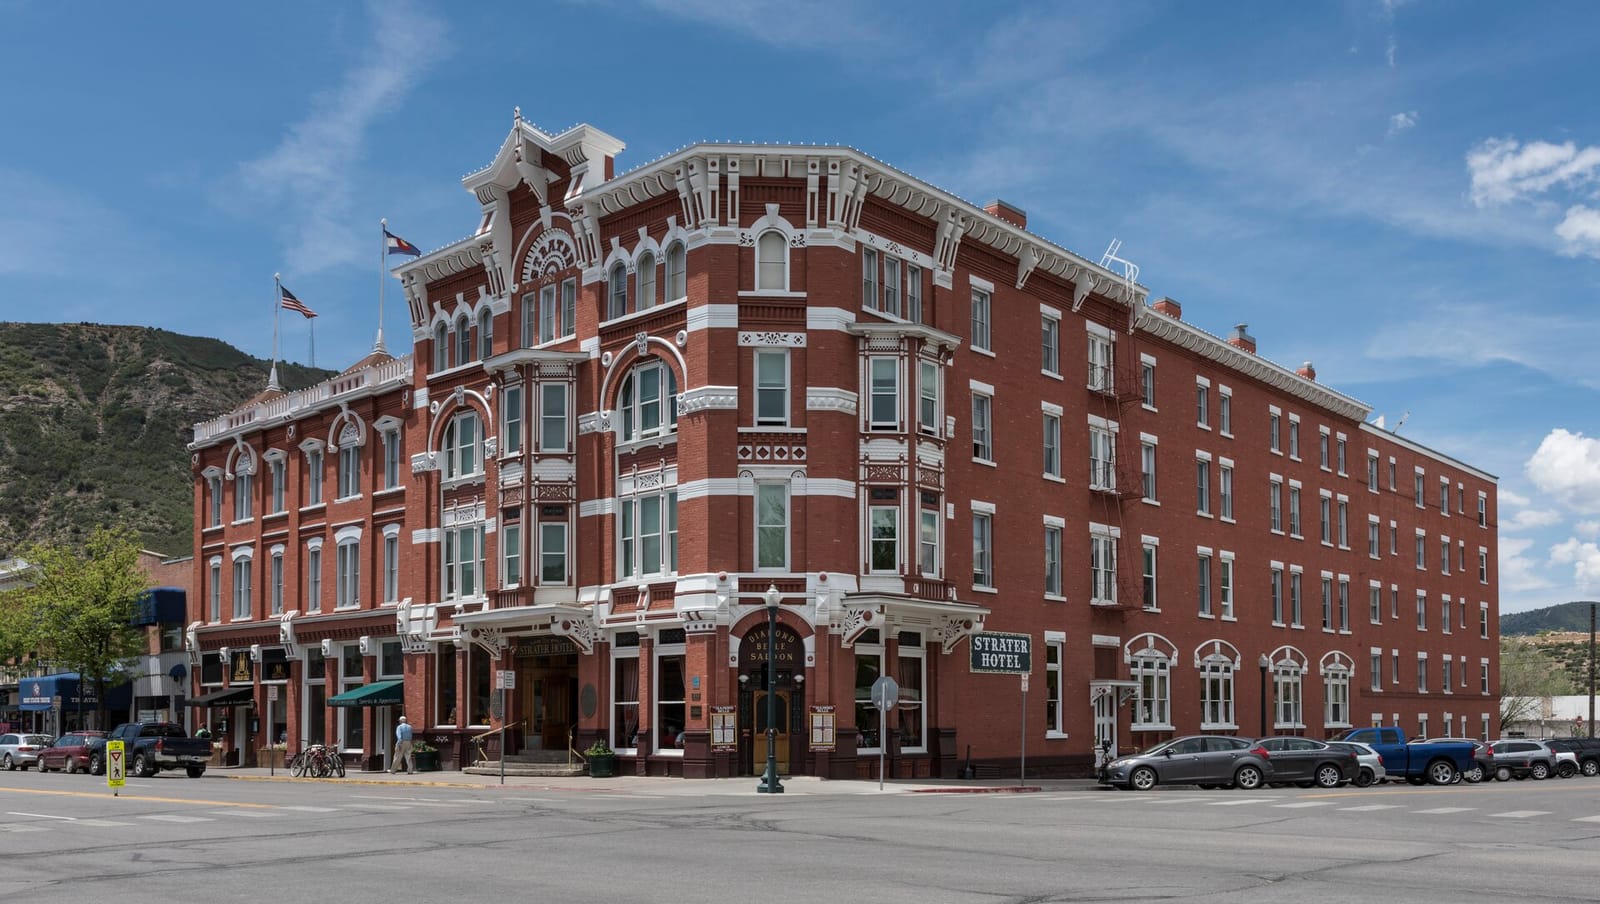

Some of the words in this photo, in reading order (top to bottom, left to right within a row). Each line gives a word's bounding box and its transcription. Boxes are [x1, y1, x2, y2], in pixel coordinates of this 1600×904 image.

[530, 238, 575, 280] STRATER
[748, 630, 795, 643] DIAOND
[974, 636, 1028, 654] STRATER
[756, 642, 786, 650] BELE
[981, 652, 1021, 669] HOTEL
